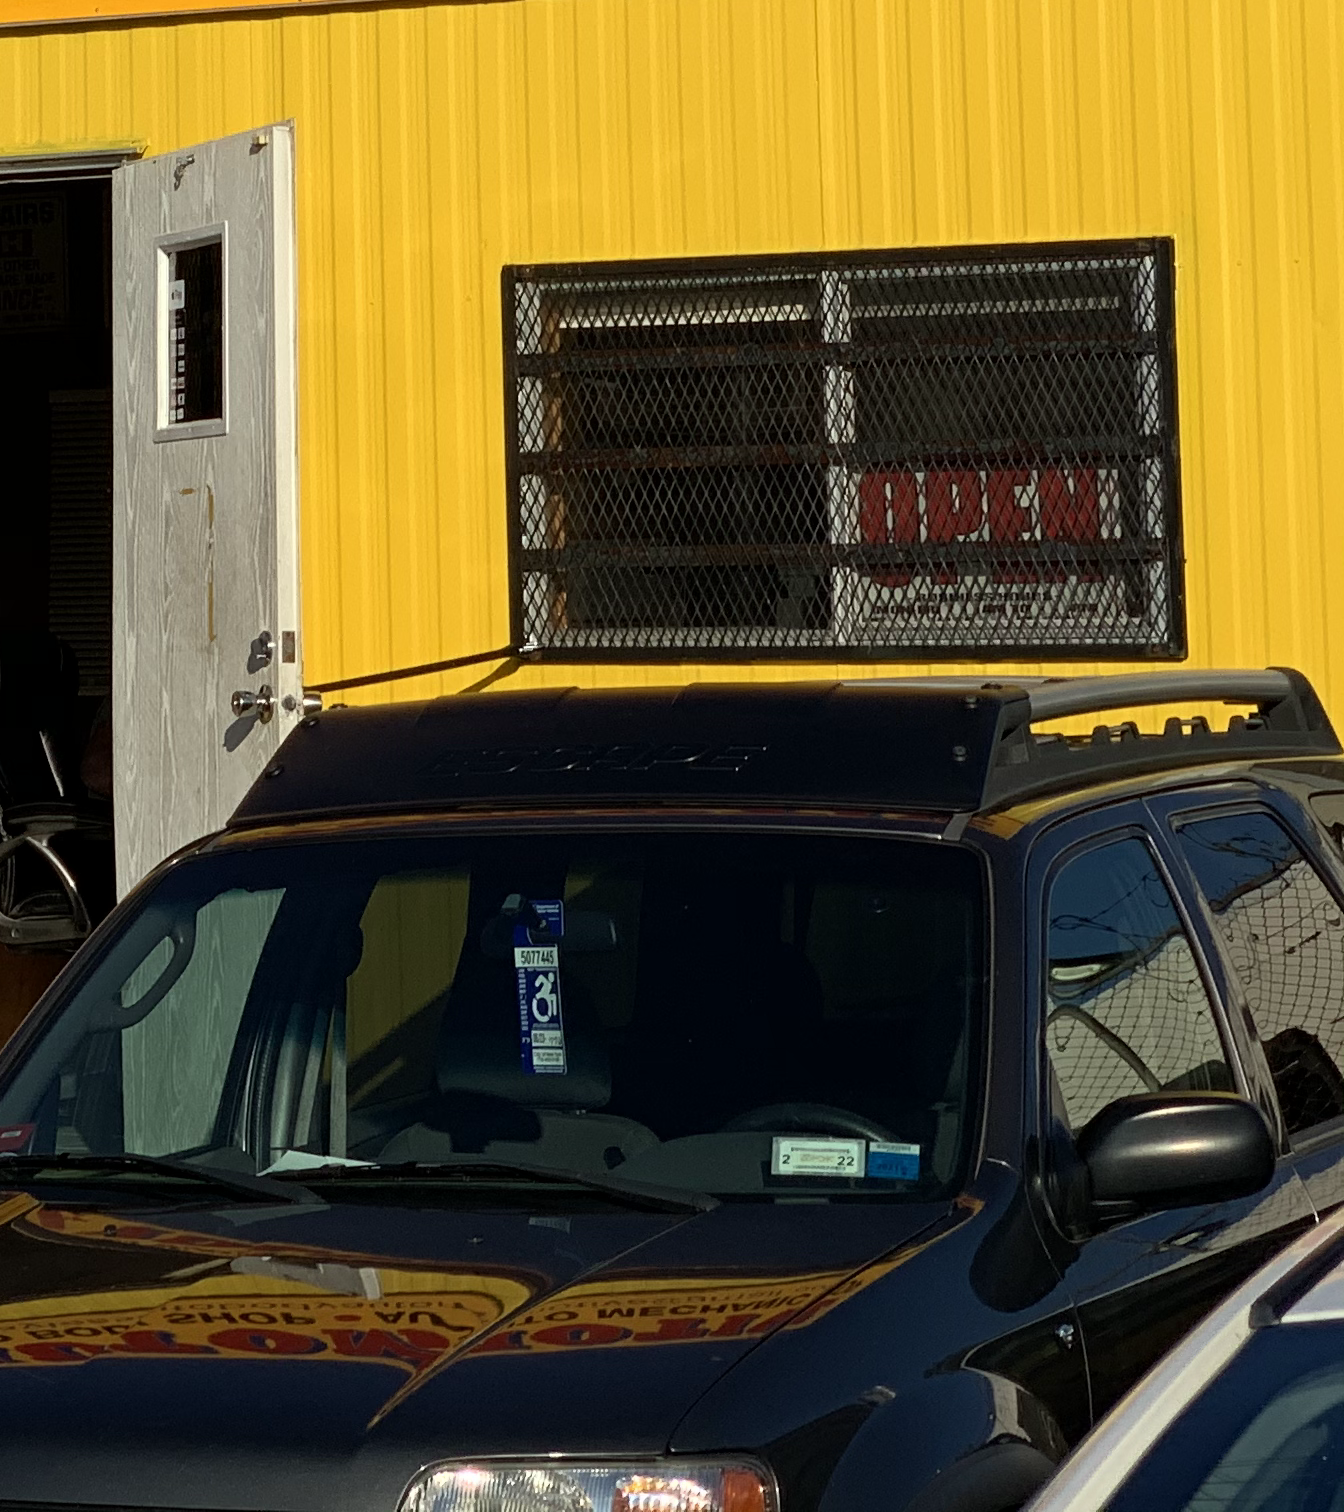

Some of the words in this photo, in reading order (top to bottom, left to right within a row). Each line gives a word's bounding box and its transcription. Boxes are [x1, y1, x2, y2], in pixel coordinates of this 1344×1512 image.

[858, 469, 1104, 587] OPEN
[781, 1154, 791, 1165] 2
[837, 1155, 855, 1167] 22
